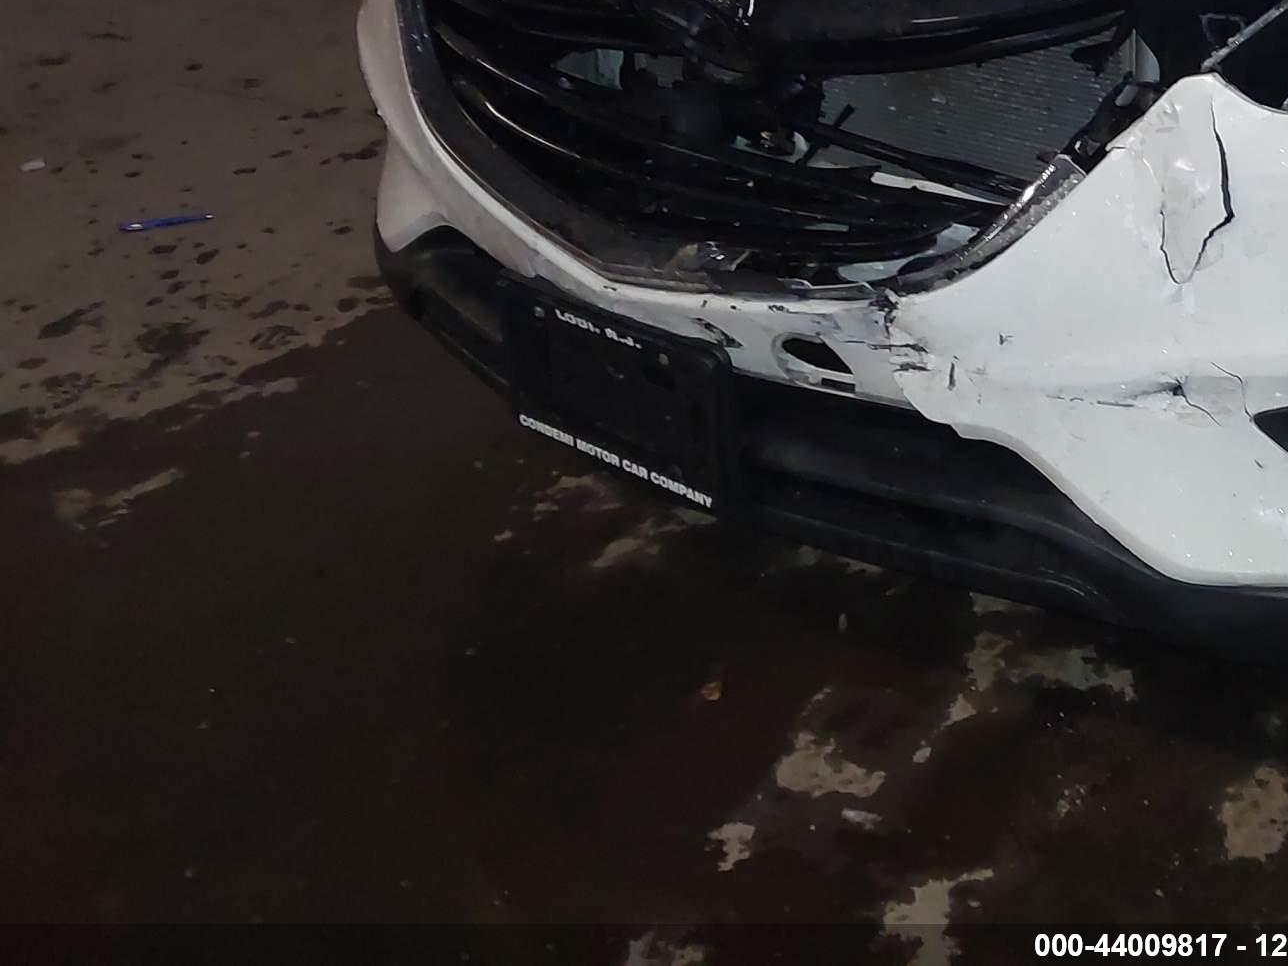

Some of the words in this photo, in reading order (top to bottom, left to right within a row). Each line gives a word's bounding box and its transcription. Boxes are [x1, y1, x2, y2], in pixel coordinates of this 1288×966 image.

[576, 438, 620, 467] MOTOR
[622, 459, 649, 480] CAR
[650, 472, 712, 508] COMPANY
